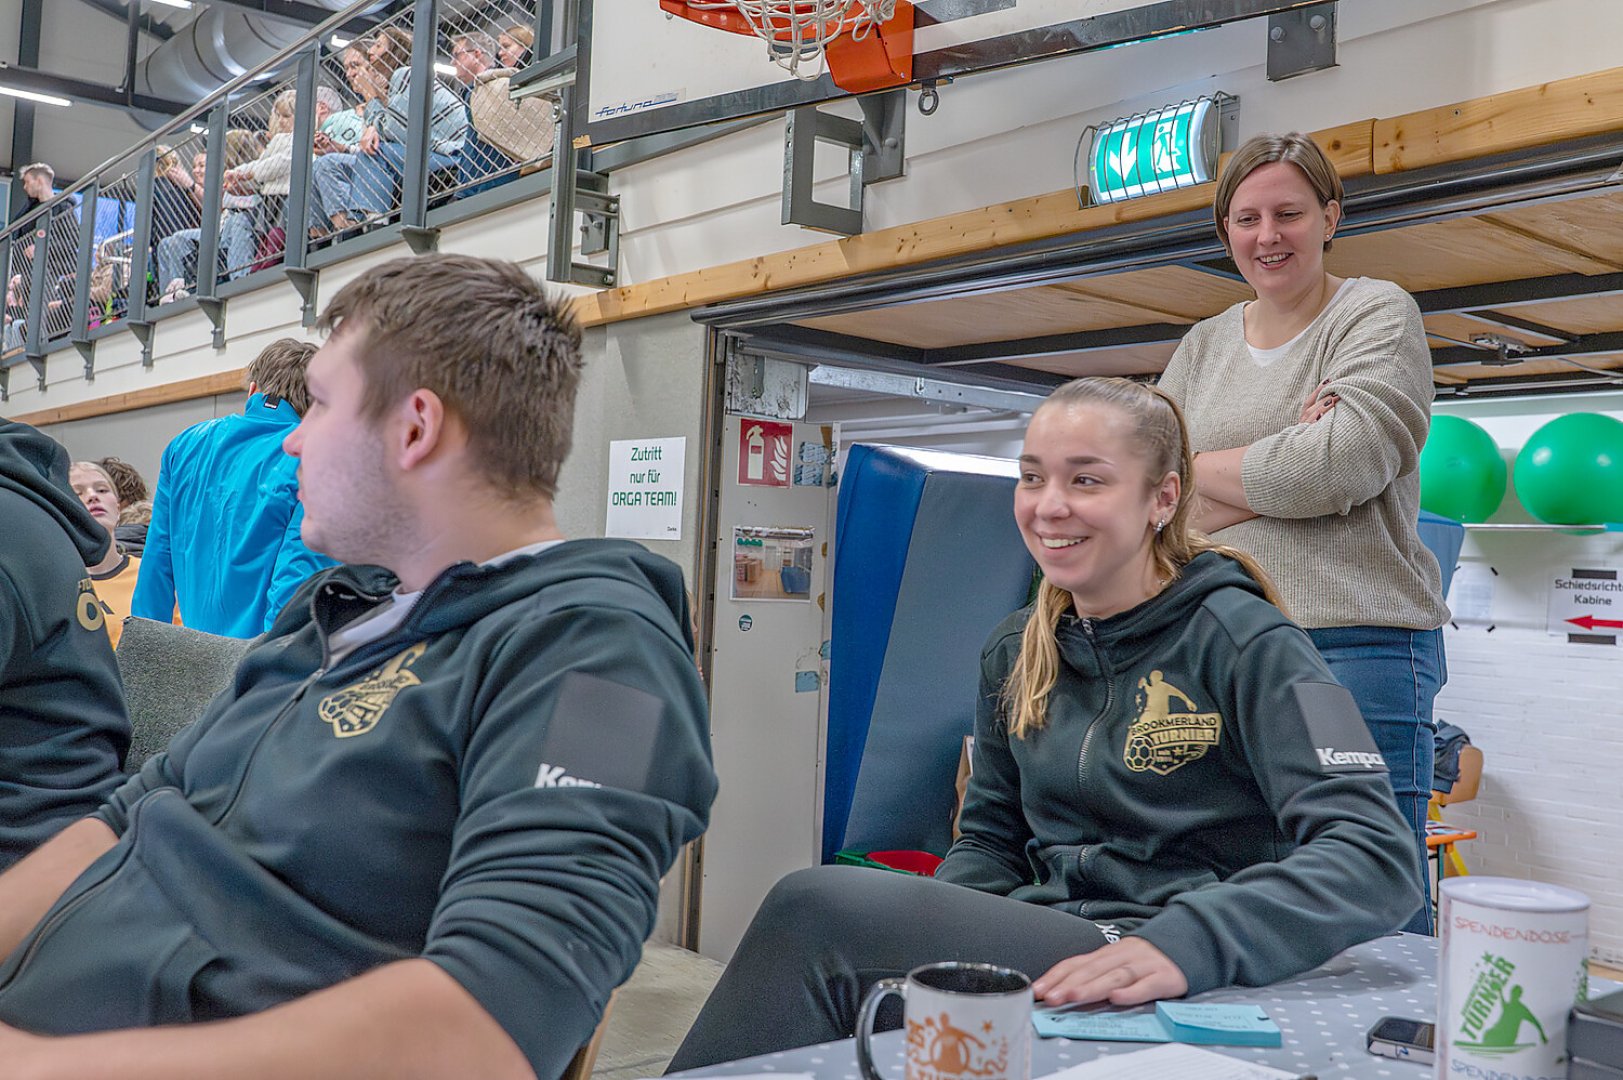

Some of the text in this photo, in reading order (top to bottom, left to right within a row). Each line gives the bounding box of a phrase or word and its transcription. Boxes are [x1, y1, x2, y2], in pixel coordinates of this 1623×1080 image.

[630, 446, 662, 461] Zutritt
[629, 469, 660, 483] nur für
[612, 491, 677, 506] ORGA TEAM!
[1574, 594, 1612, 606] Kabine
[1149, 728, 1215, 745] TURNIER
[1315, 747, 1386, 768] Kempa
[1454, 916, 1571, 944] SPENDENDOSE
